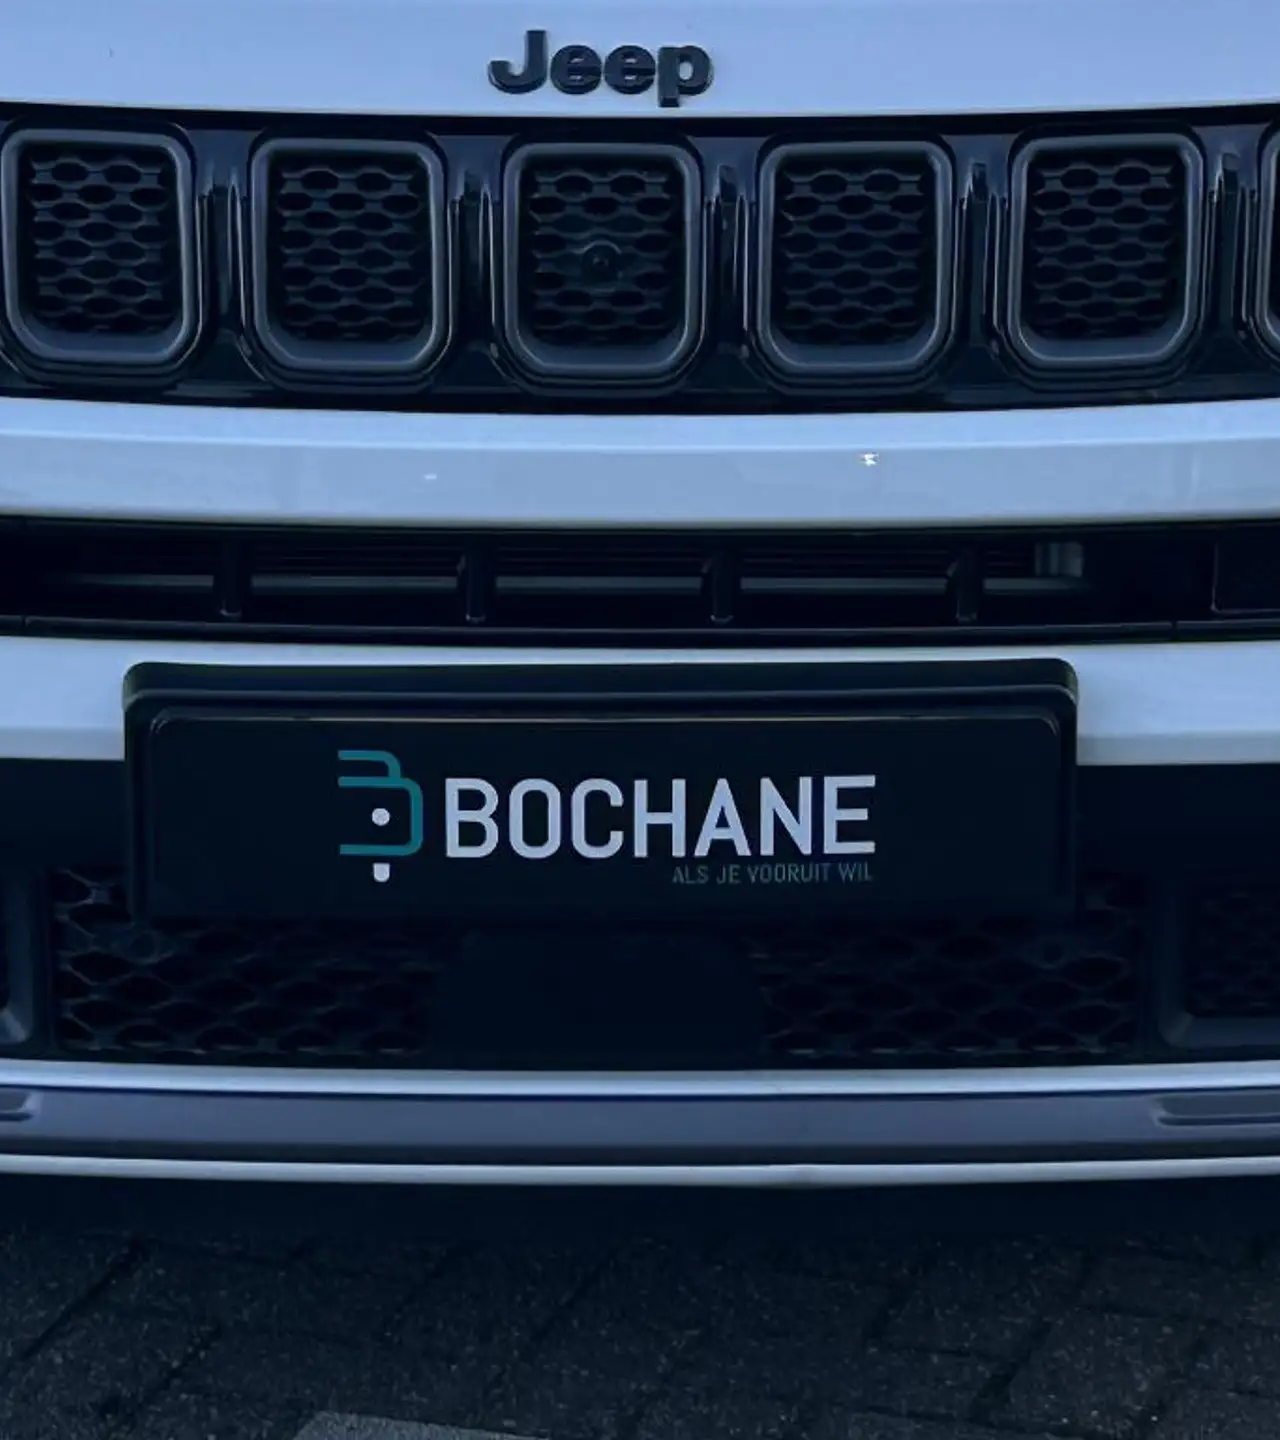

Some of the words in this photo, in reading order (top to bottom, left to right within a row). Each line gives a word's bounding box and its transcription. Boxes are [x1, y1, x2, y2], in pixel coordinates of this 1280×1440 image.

[488, 30, 714, 108] Jeep
[445, 774, 876, 859] BOCHANE
[672, 865, 709, 885] ALS
[716, 864, 741, 884] JE
[747, 862, 831, 884] VOORUIT
[838, 861, 874, 883] WIL
